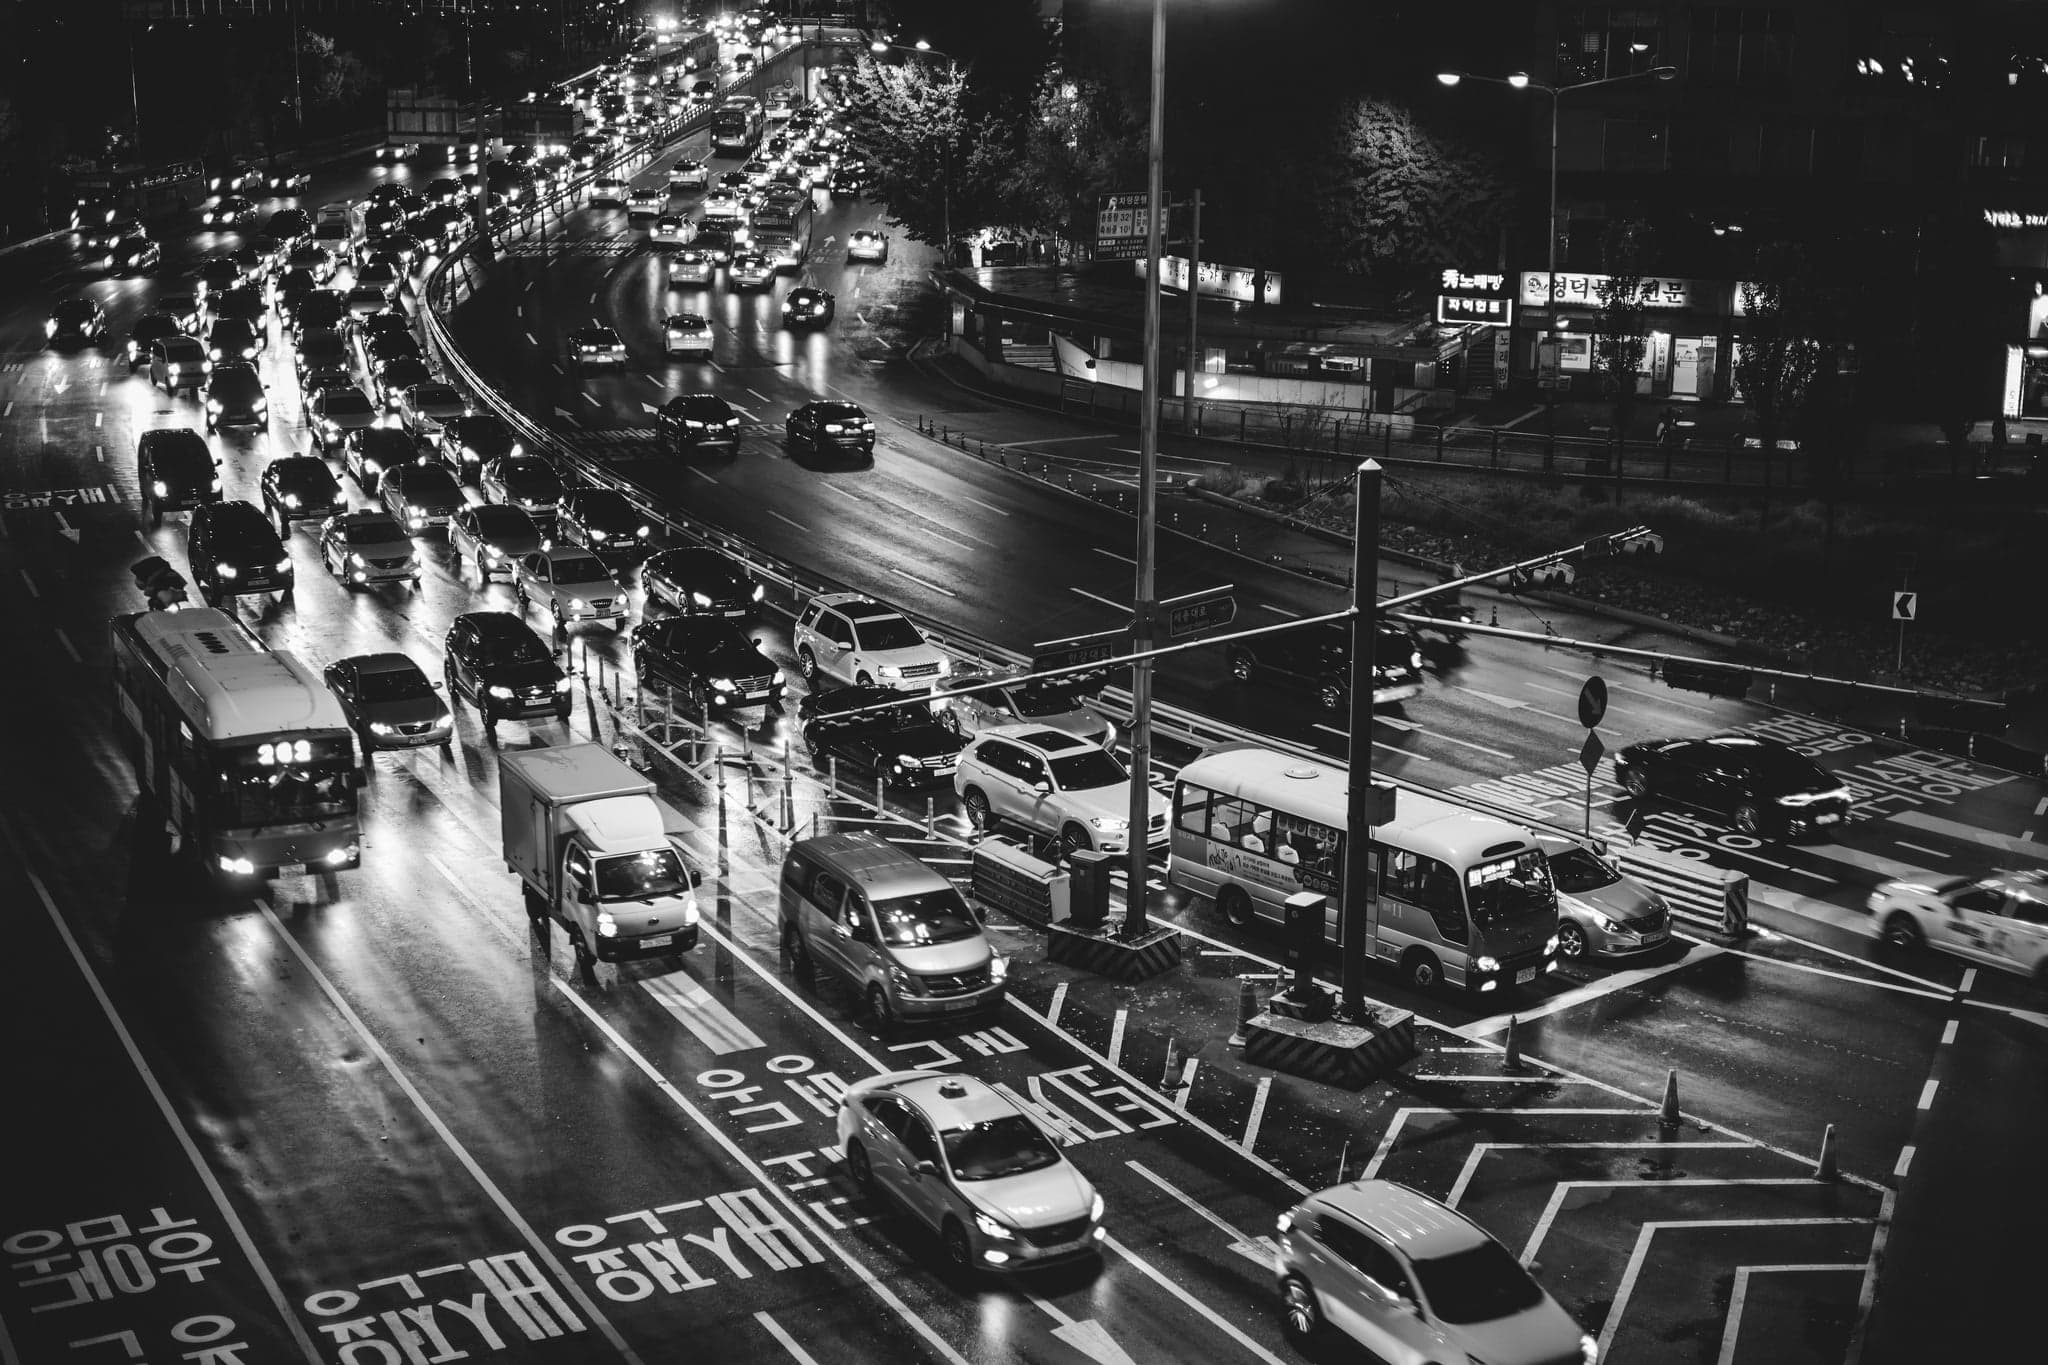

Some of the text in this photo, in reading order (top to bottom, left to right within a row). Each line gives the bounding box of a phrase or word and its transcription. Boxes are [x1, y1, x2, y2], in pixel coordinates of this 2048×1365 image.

[1448, 298, 1500, 313] 자이언트
[1855, 750, 2021, 796] 숭례문
[1, 1206, 222, 1315] 후암동
[554, 1187, 825, 1303] 버스전용
